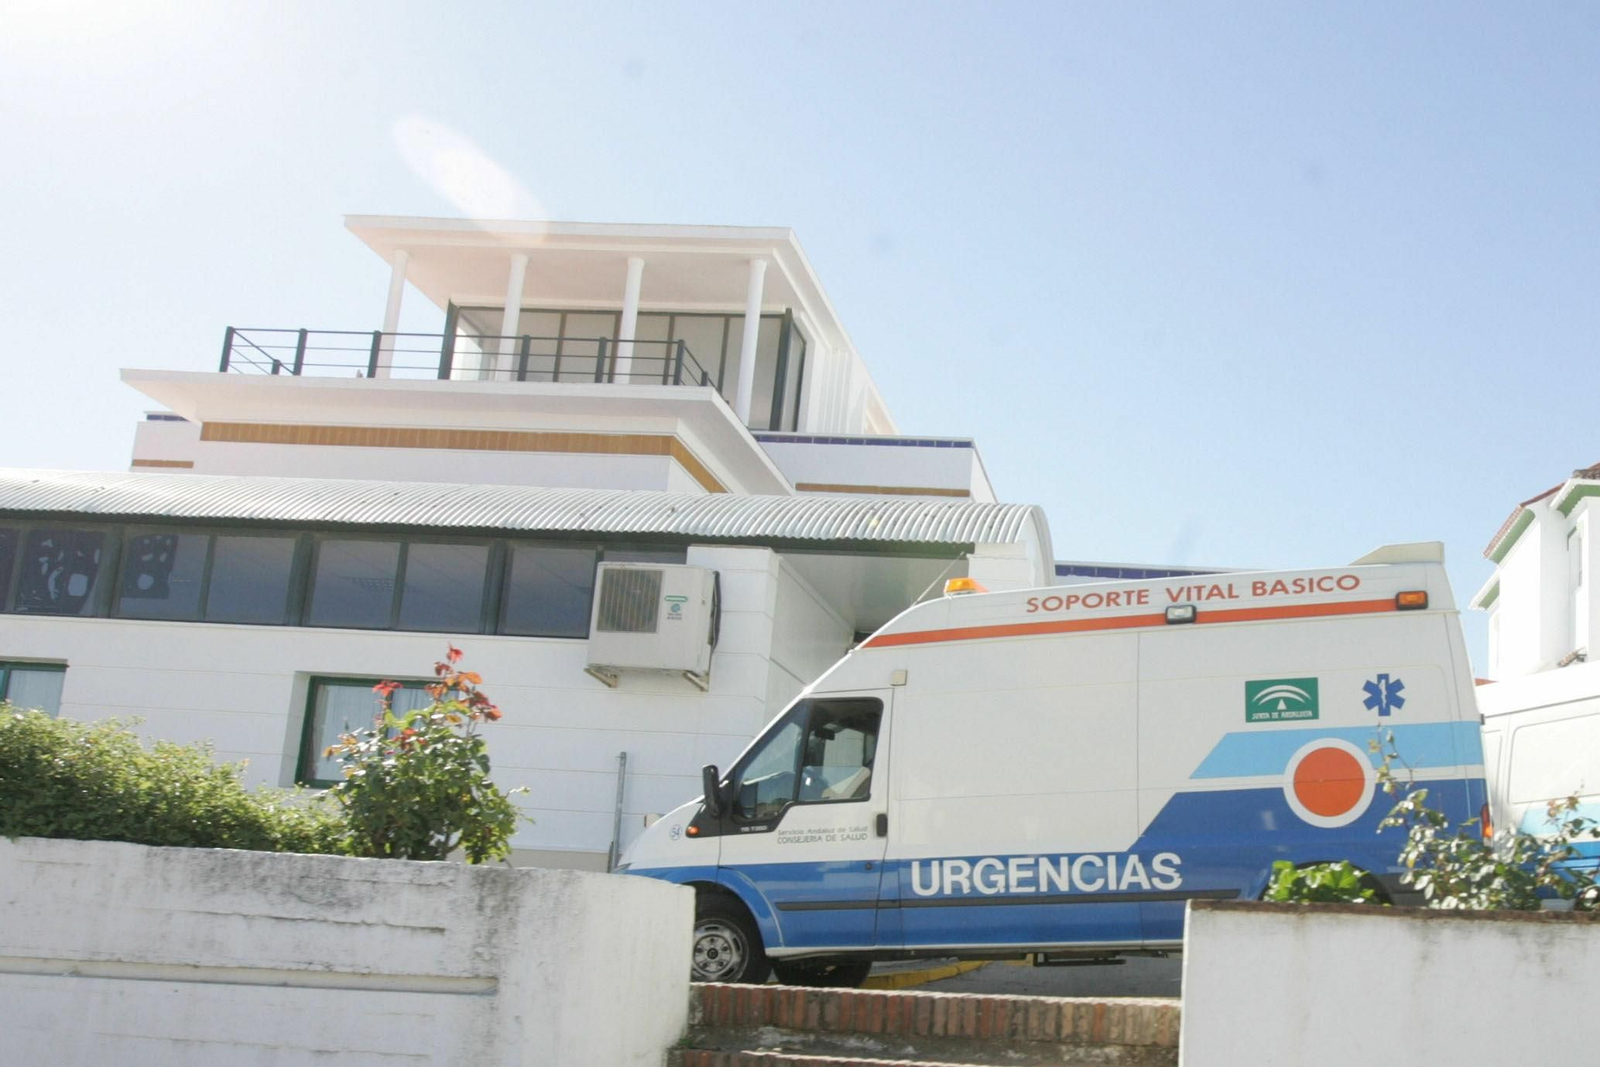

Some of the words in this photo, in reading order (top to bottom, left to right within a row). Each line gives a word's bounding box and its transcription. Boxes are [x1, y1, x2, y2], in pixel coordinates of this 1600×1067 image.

[1026, 588, 1150, 613] SOPORTE
[1165, 583, 1240, 603] VITAL
[1251, 574, 1361, 598] BASICO
[1251, 712, 1270, 720] JUNTA
[1271, 711, 1279, 719] DE
[777, 835, 822, 844] CONSEJERIA
[825, 834, 837, 842] DE
[840, 833, 868, 841] SALUD
[911, 852, 1182, 896] URGENCIAS
